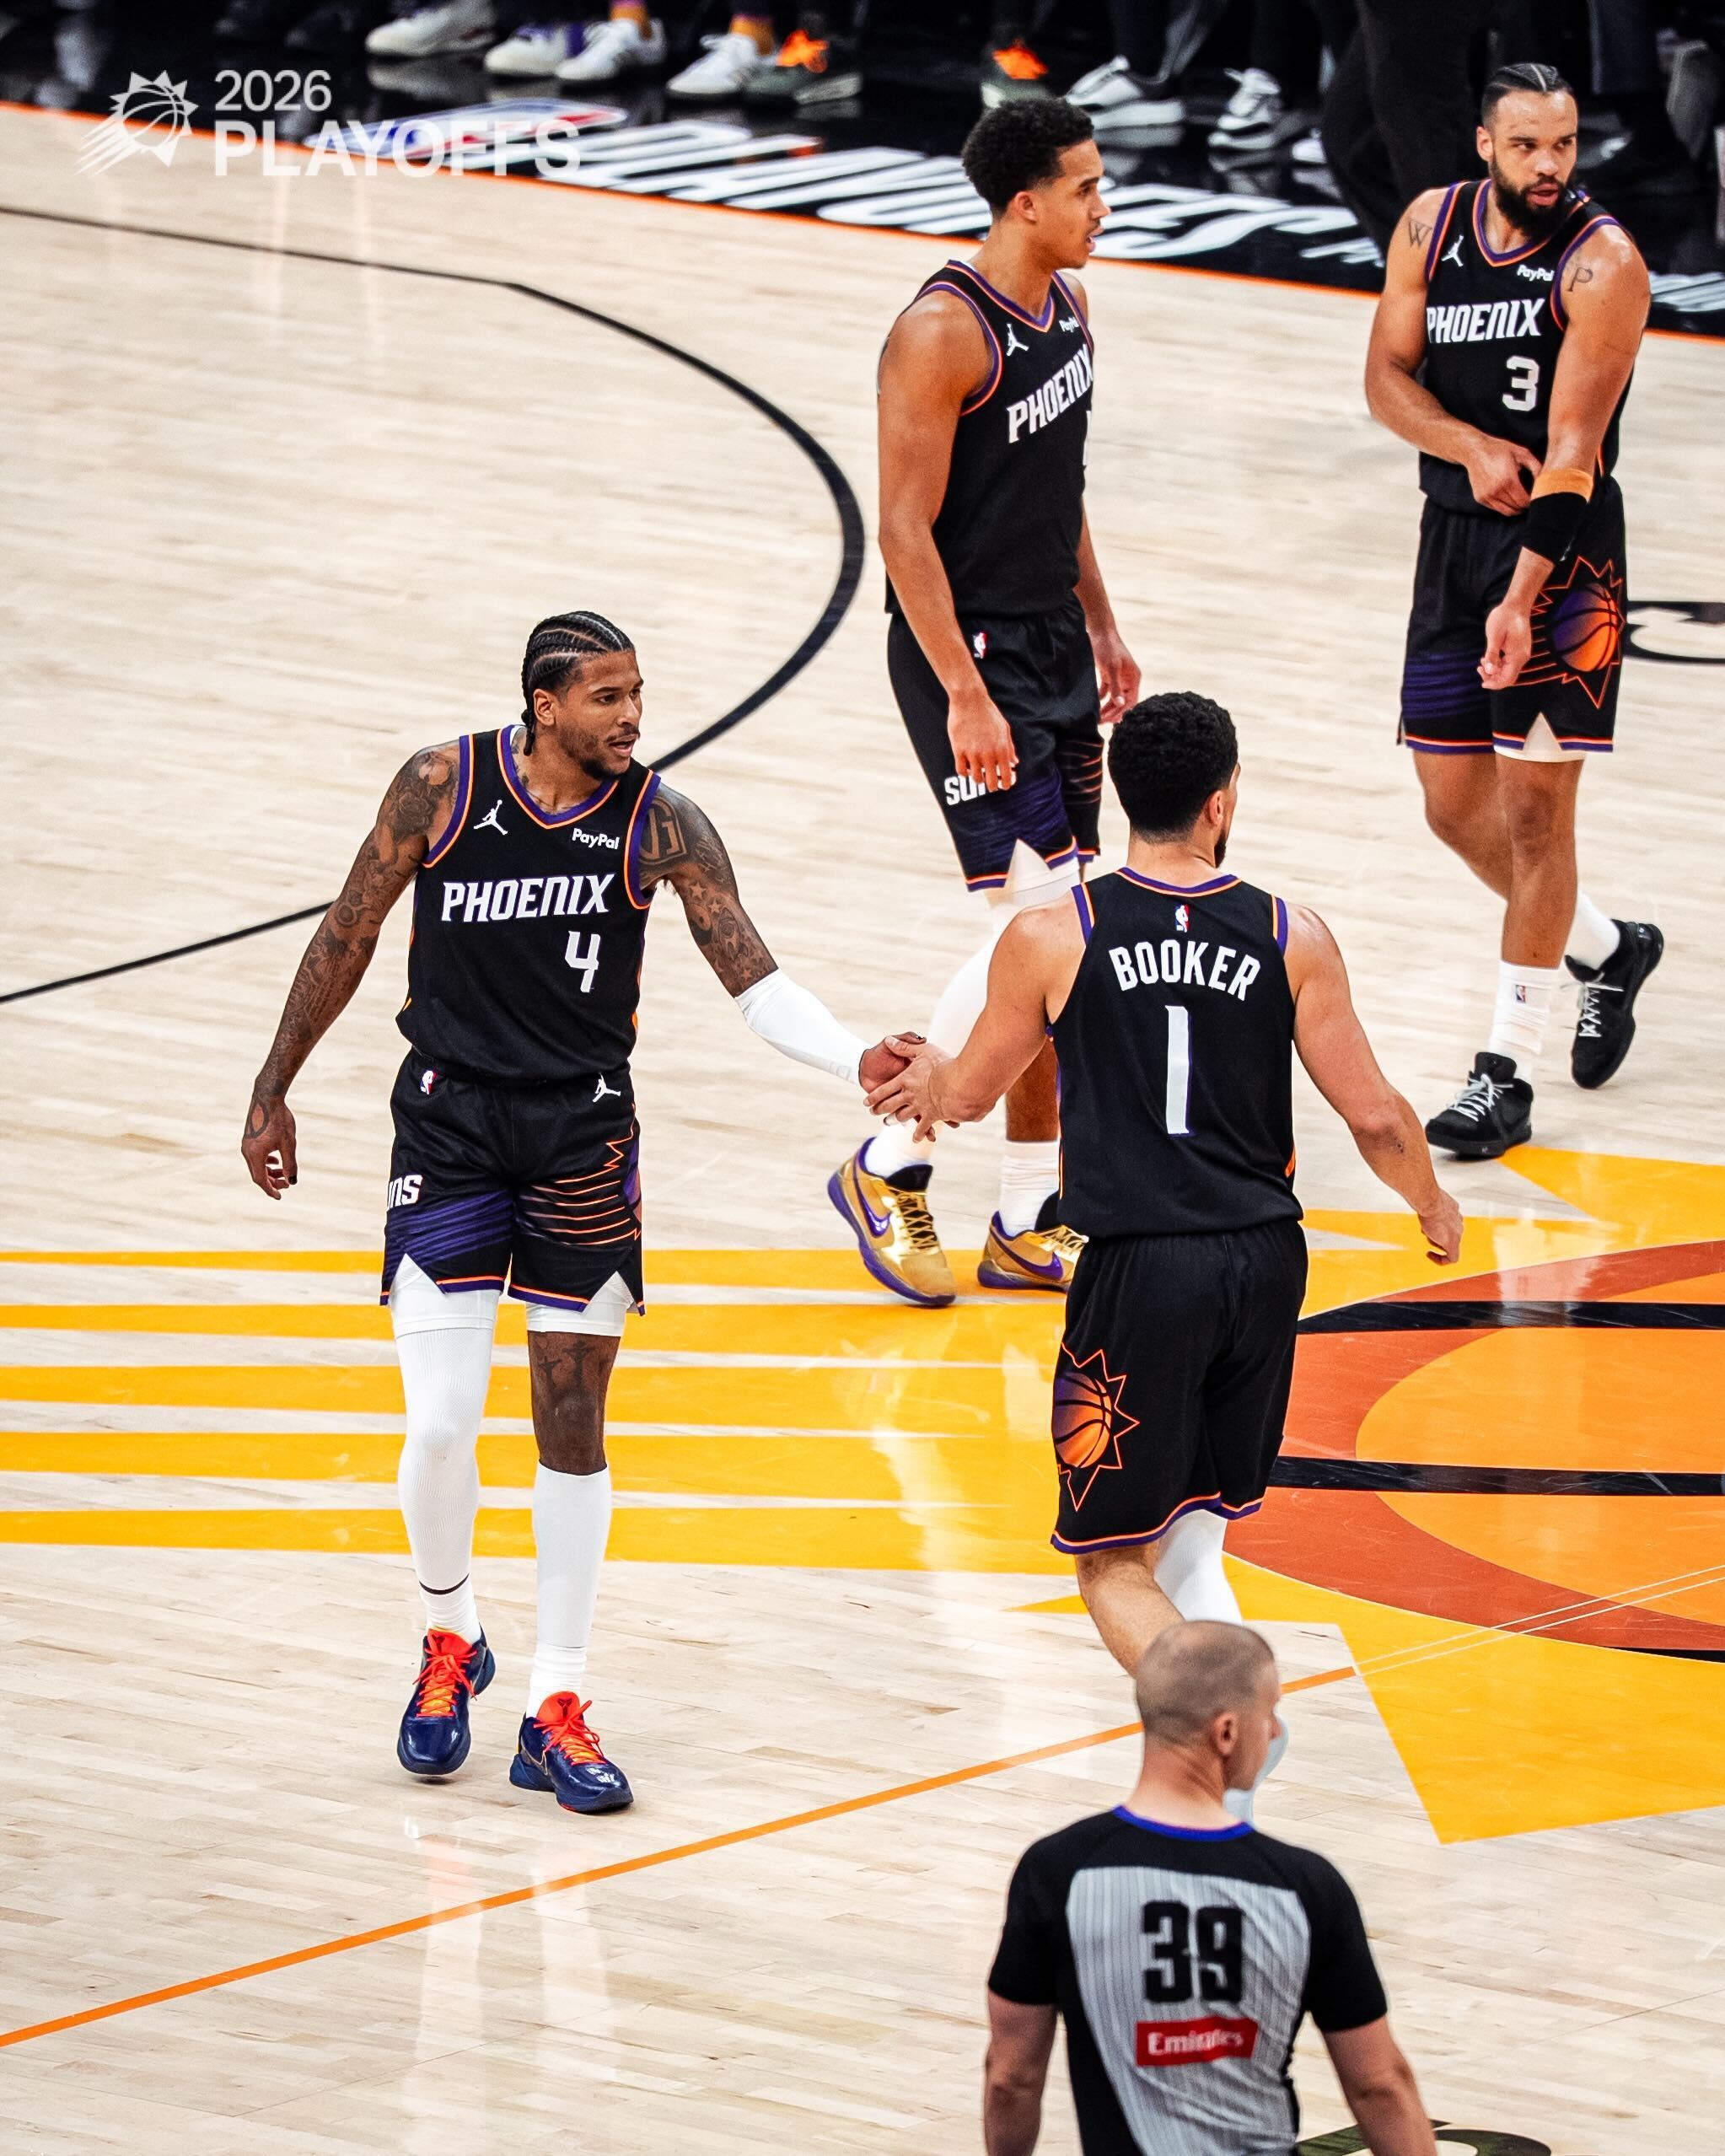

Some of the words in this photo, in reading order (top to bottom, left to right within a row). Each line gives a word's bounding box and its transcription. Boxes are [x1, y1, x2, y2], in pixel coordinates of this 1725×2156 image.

[1518, 264, 1554, 282] PayPal
[1567, 266, 1593, 293] P
[1427, 298, 1545, 344] PHOENIX
[1006, 343, 1094, 444] PHOENIX
[1502, 355, 1540, 412] 3
[572, 827, 620, 850] PayPal
[440, 873, 615, 922] PHOENIX
[564, 930, 601, 993] 4
[1108, 938, 1261, 1002] BOOKER
[1165, 1004, 1191, 1136] 1
[1142, 1901, 1244, 2004] 39
